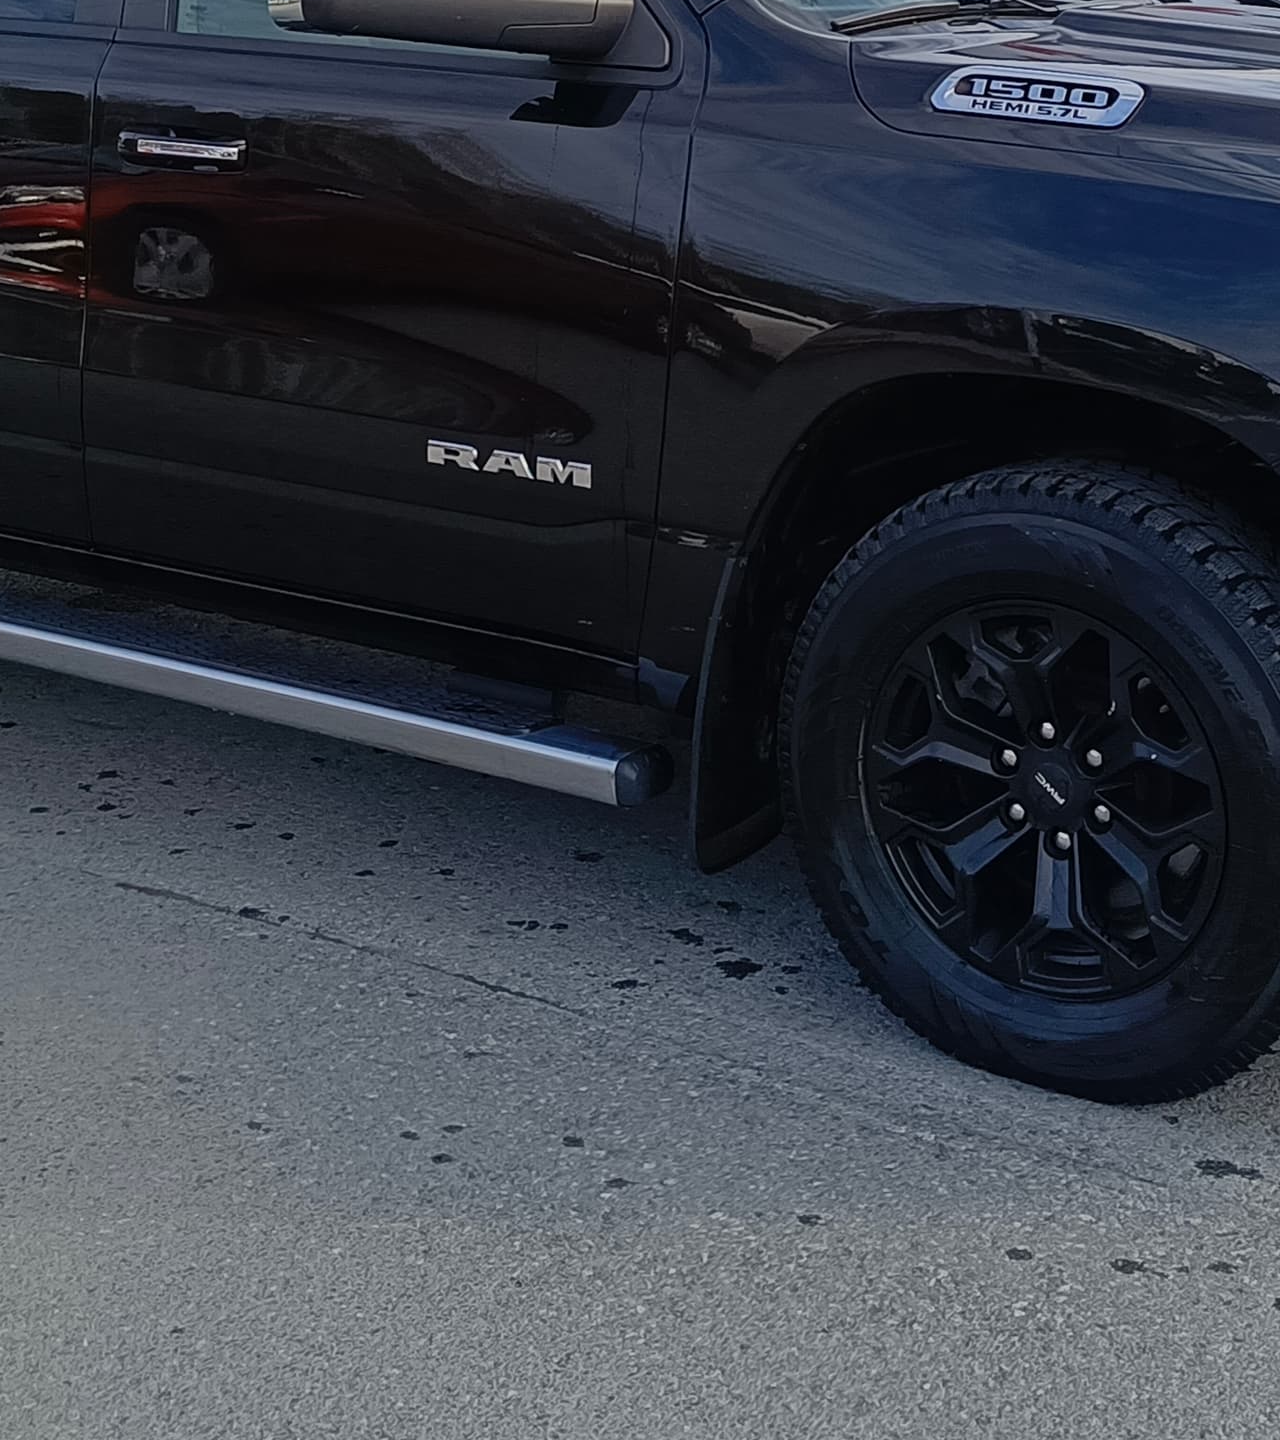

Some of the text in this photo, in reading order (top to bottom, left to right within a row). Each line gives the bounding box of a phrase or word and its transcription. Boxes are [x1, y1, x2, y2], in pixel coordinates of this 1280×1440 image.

[970, 78, 1109, 108] 1500
[971, 98, 1088, 120] HEMI 5.7L
[427, 439, 592, 489] RAM
